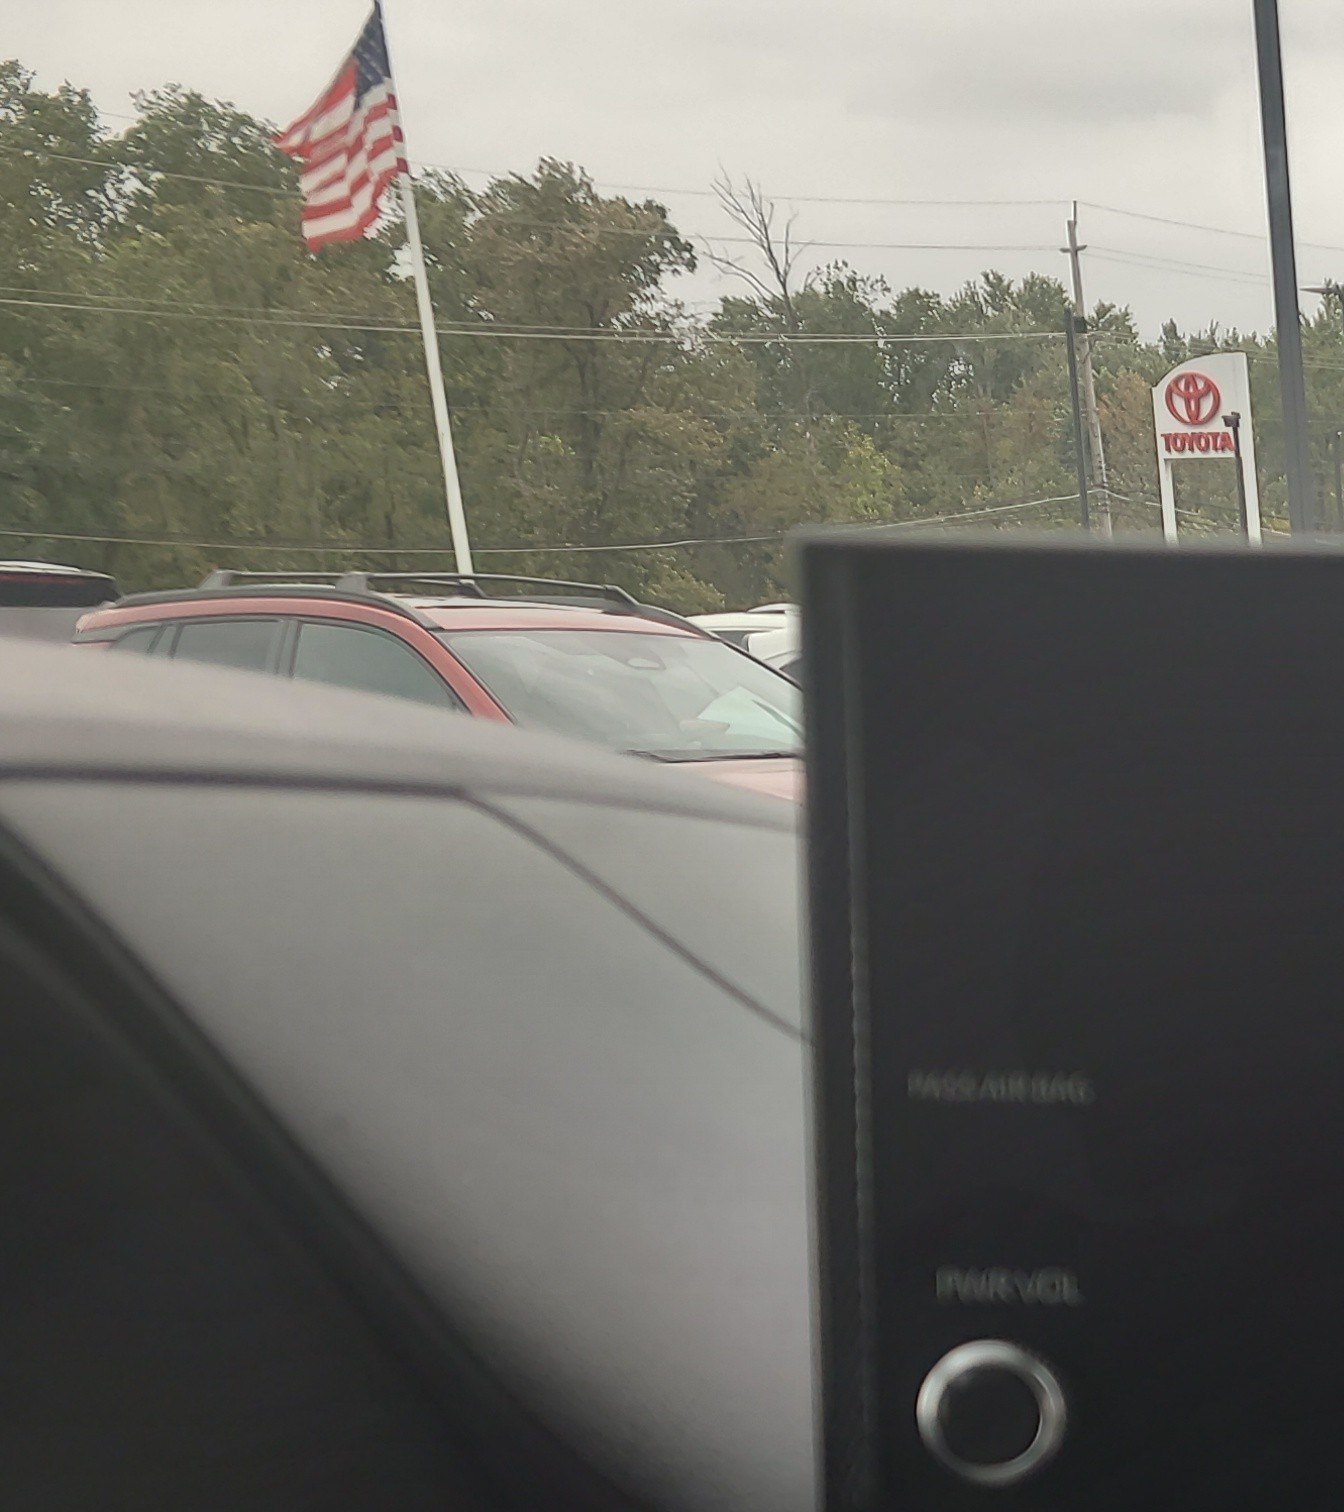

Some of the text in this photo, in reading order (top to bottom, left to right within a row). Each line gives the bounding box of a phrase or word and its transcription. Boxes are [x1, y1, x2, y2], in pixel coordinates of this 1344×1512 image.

[1160, 432, 1236, 452] TOYOTA
[936, 1266, 1085, 1306] PWR VOL
